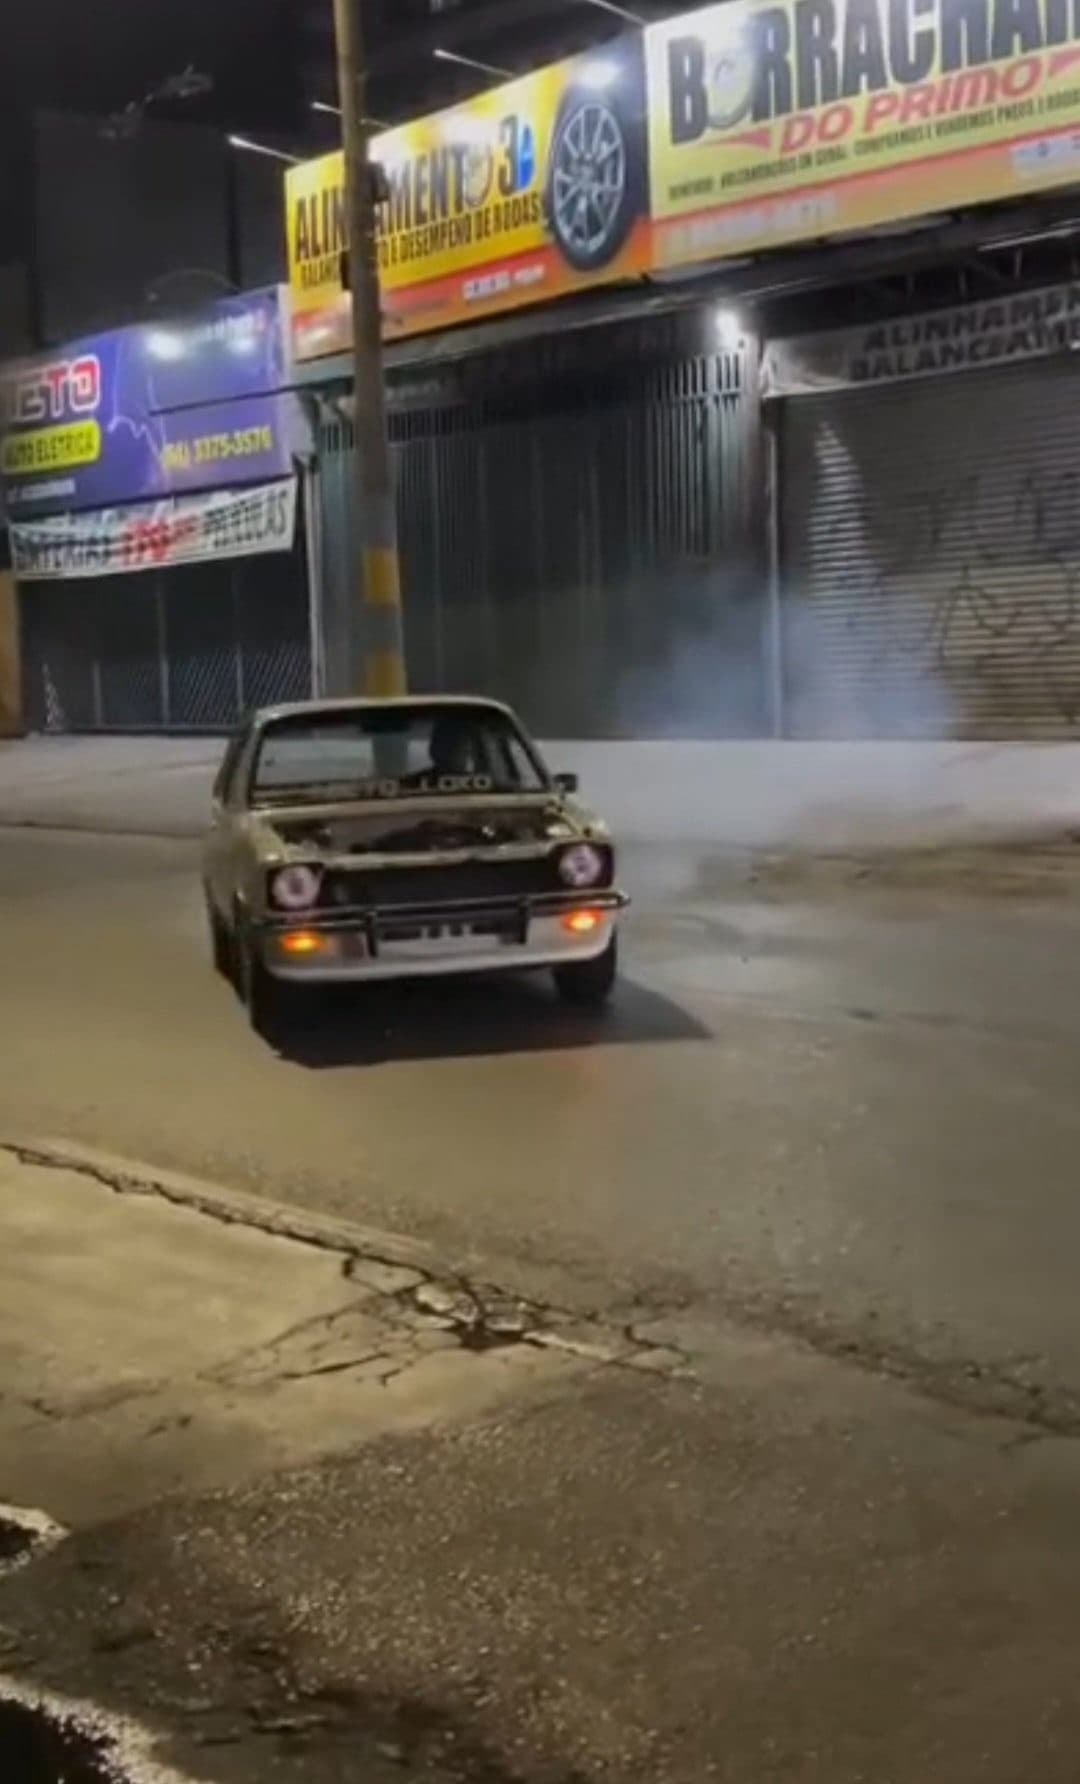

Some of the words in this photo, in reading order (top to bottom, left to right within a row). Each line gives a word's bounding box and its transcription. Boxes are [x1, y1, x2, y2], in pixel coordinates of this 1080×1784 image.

[779, 104, 855, 155] DO
[862, 56, 1043, 134] PRIMO
[295, 143, 493, 264] ALINMENTO
[493, 190, 538, 234] RODAS
